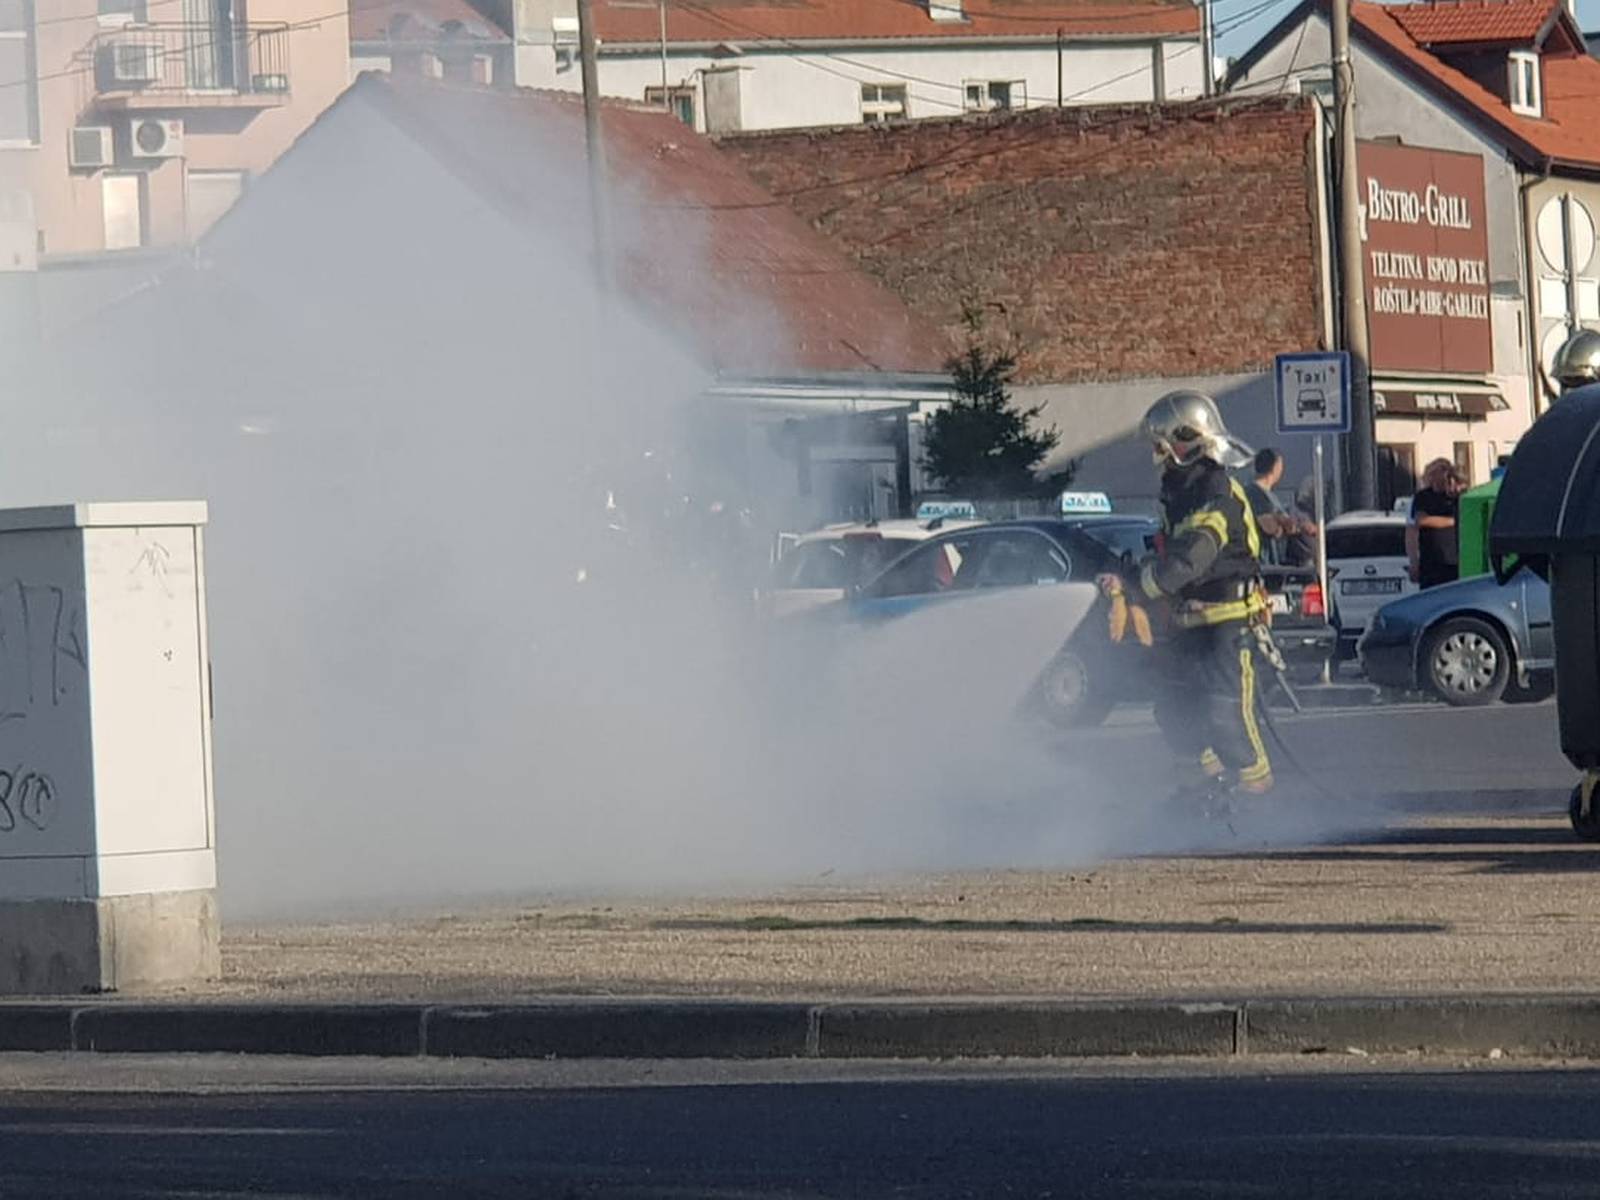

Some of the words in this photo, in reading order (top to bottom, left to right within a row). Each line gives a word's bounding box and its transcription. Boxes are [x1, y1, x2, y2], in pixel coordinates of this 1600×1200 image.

[1371, 251, 1424, 279] TELETINA
[1427, 256, 1457, 283] ISPOD
[1295, 370, 1326, 384] Taxi
